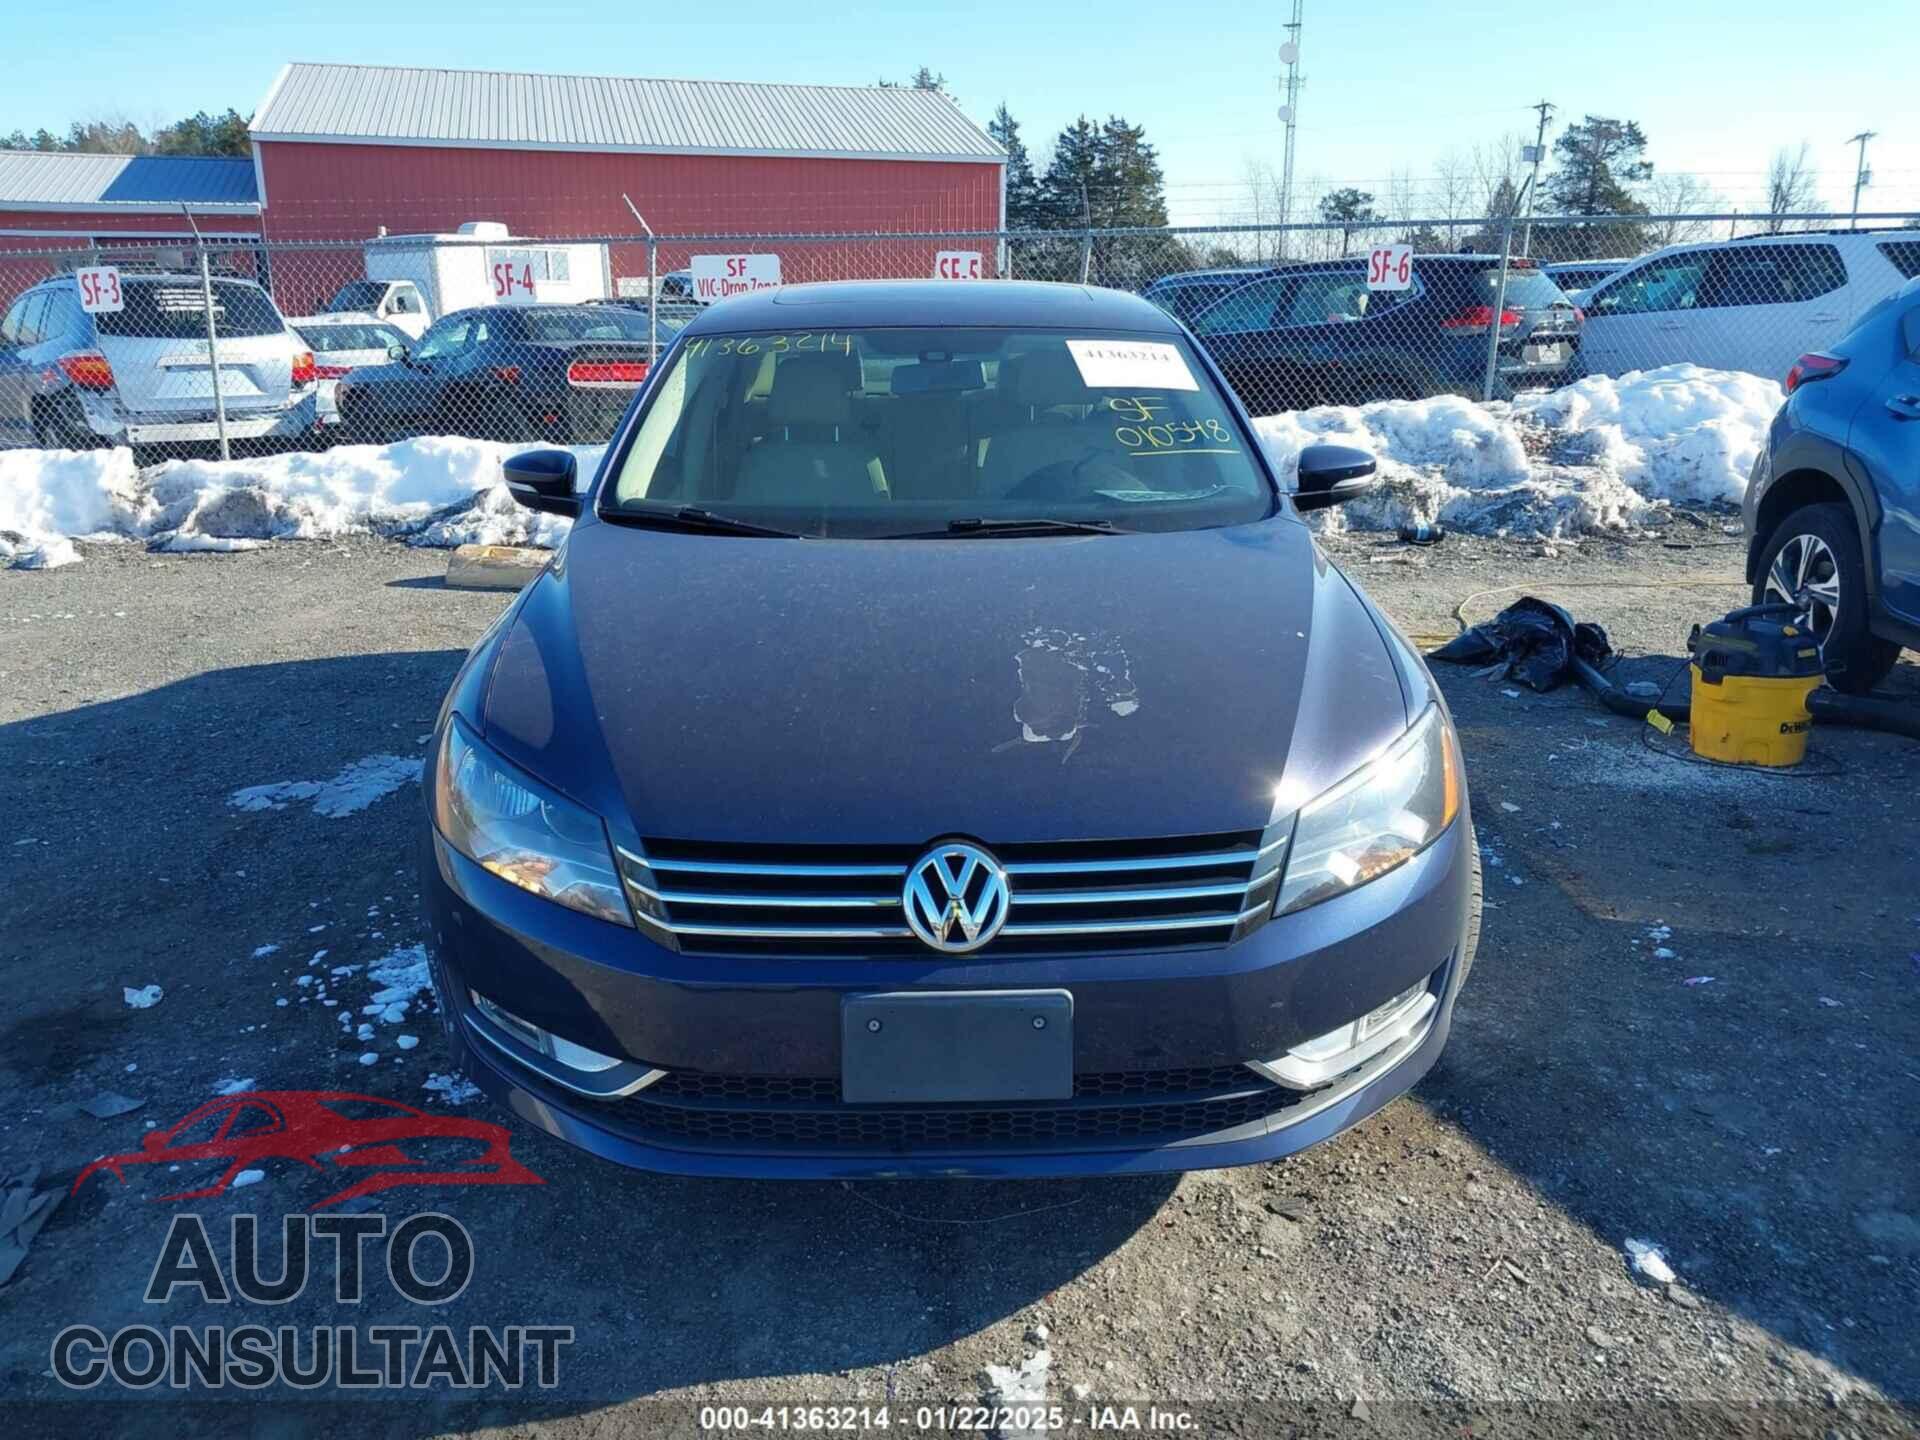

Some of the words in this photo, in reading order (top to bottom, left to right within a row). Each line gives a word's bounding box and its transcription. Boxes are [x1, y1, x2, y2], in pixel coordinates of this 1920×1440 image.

[494, 263, 534, 297] SF-4
[726, 258, 747, 277] SF
[1370, 250, 1409, 284] SF-6
[81, 273, 120, 306] SF-3
[684, 332, 852, 359] 41363214
[1109, 397, 1168, 422] SF
